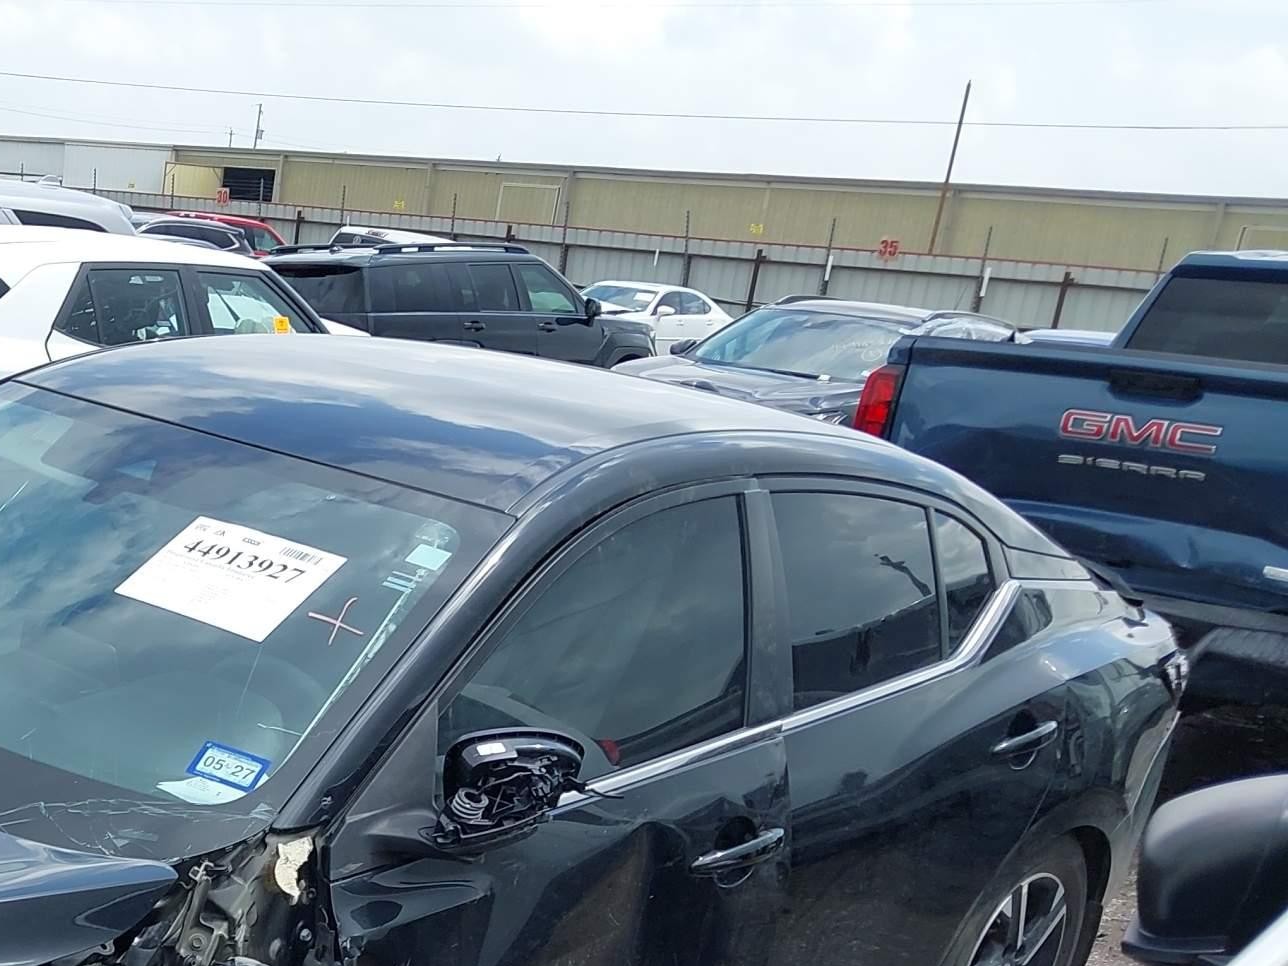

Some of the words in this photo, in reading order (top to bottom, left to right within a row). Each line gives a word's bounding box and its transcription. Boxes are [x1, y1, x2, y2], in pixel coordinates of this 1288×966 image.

[879, 240, 899, 256] 35
[1059, 408, 1224, 454] GMC
[1057, 454, 1206, 481] SIERRA
[183, 539, 306, 584] 44913927
[203, 755, 226, 771] 05
[230, 764, 256, 780] 27
